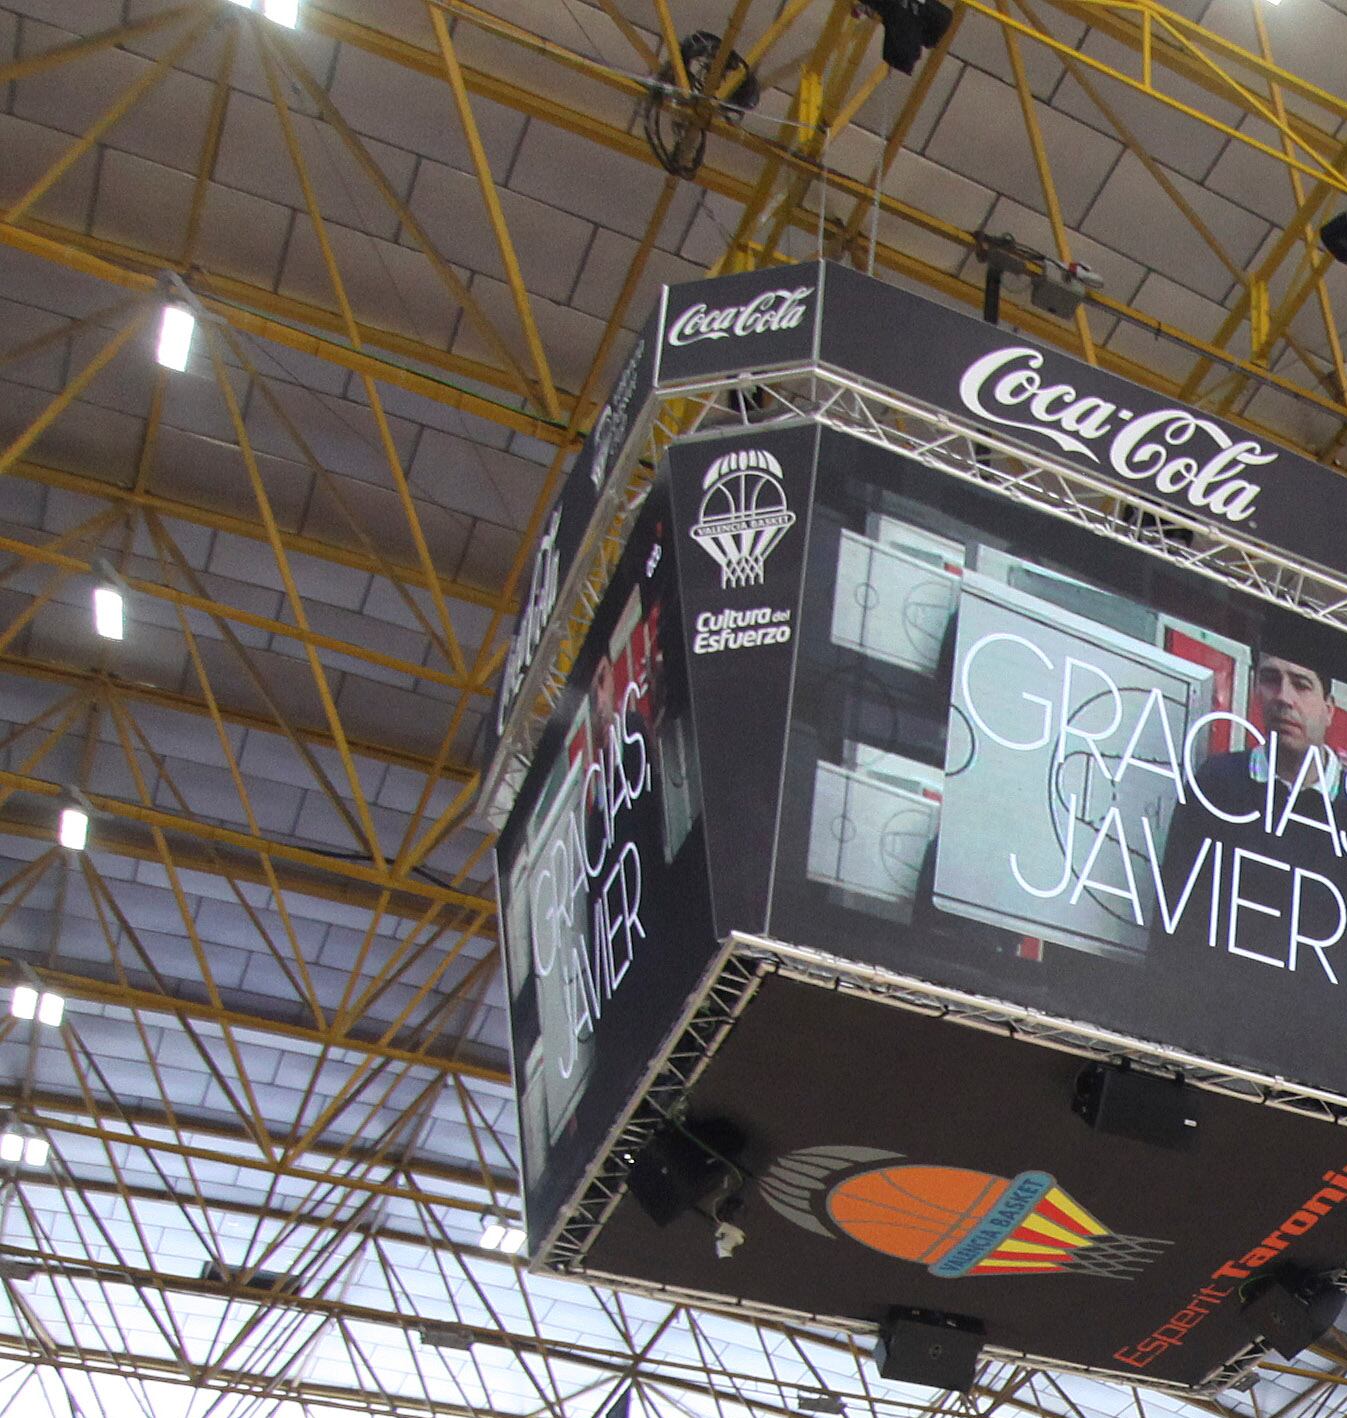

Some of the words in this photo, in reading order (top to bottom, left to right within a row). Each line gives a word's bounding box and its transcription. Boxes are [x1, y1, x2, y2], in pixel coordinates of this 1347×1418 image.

[669, 286, 815, 347] Coca-Cola
[959, 347, 1279, 521] Coca-Cola
[697, 520, 748, 537] VALENCIA
[693, 624, 791, 655] Esfuerzo
[696, 608, 771, 634] Cultura
[771, 609, 790, 623] del
[1010, 794, 1347, 984] JAVIER
[941, 1225, 1003, 1276] VALENCIA
[991, 1176, 1046, 1238] BASKET
[1112, 1283, 1234, 1369] Esperit
